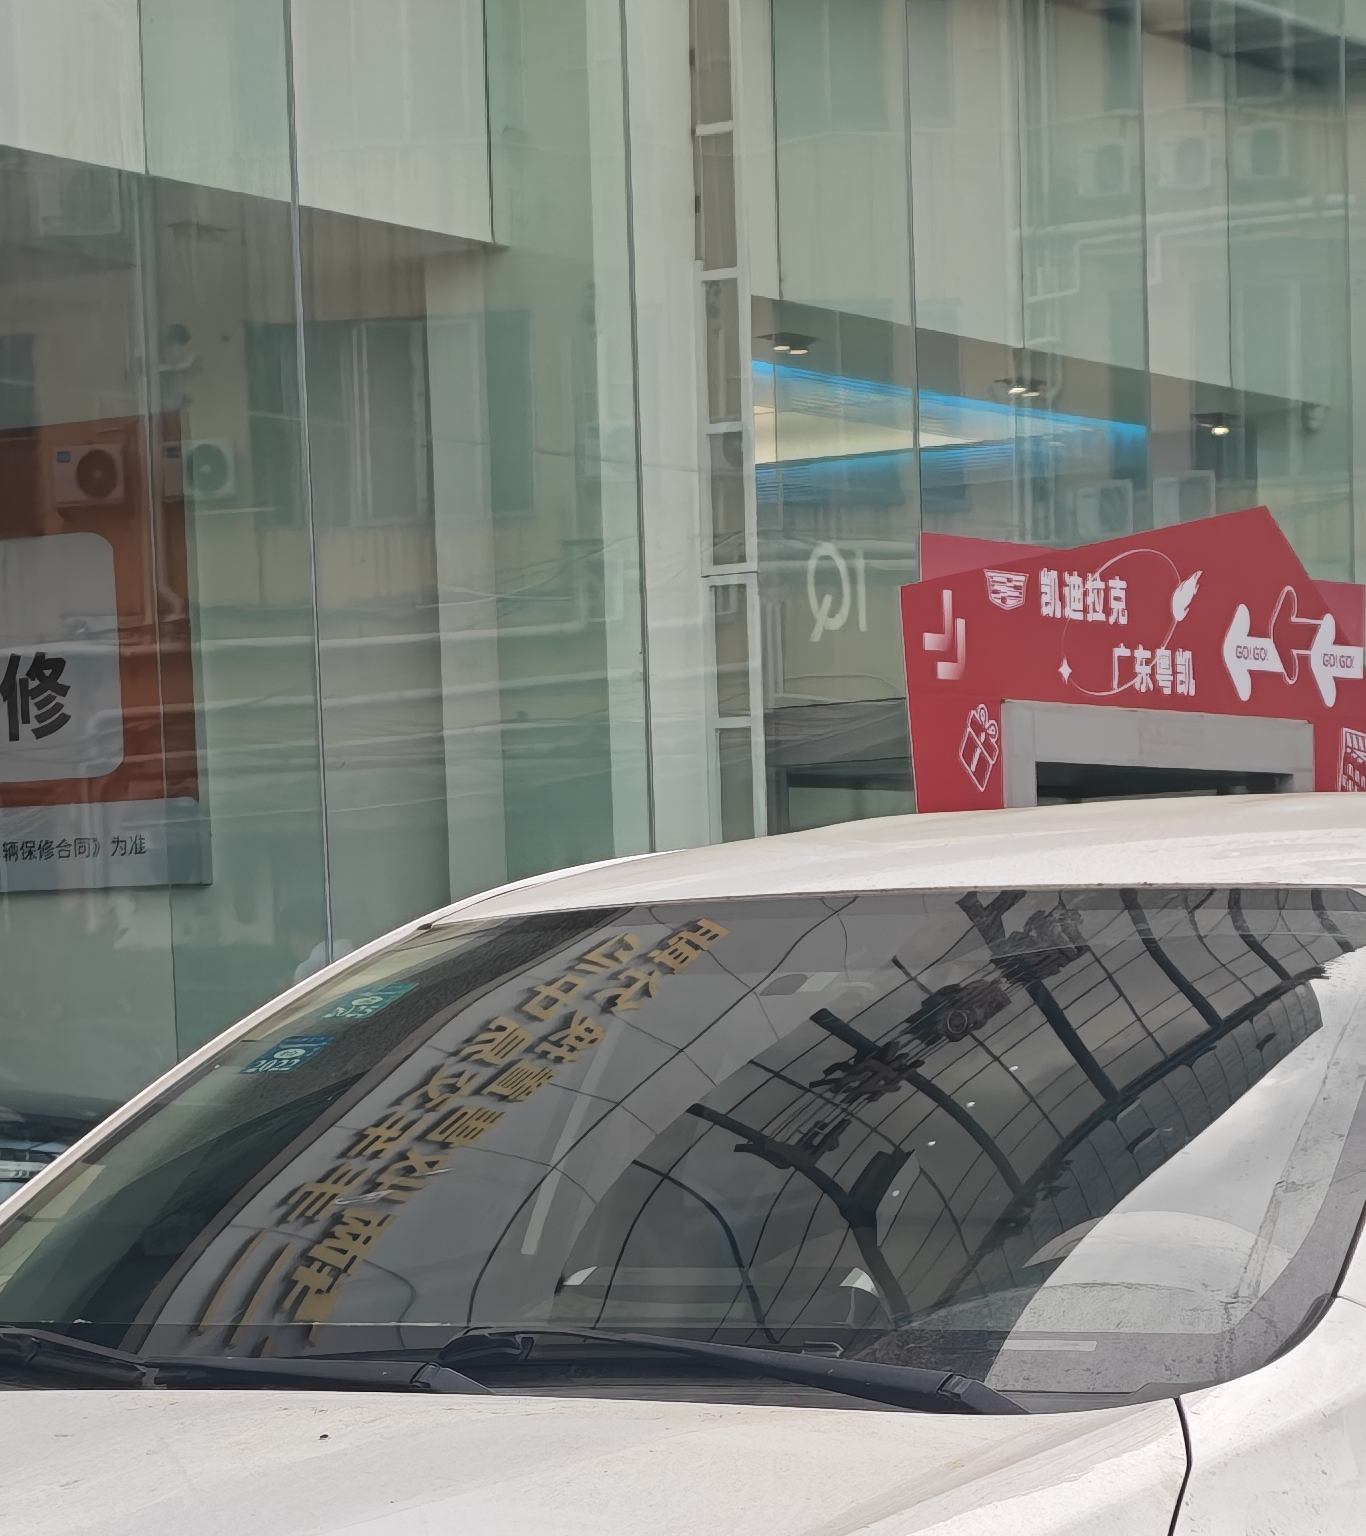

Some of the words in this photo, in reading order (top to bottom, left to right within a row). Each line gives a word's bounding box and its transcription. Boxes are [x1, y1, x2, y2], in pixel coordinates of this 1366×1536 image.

[1039, 567, 1128, 625] 凯迪拉克
[1112, 642, 1197, 697] 广东粤凯
